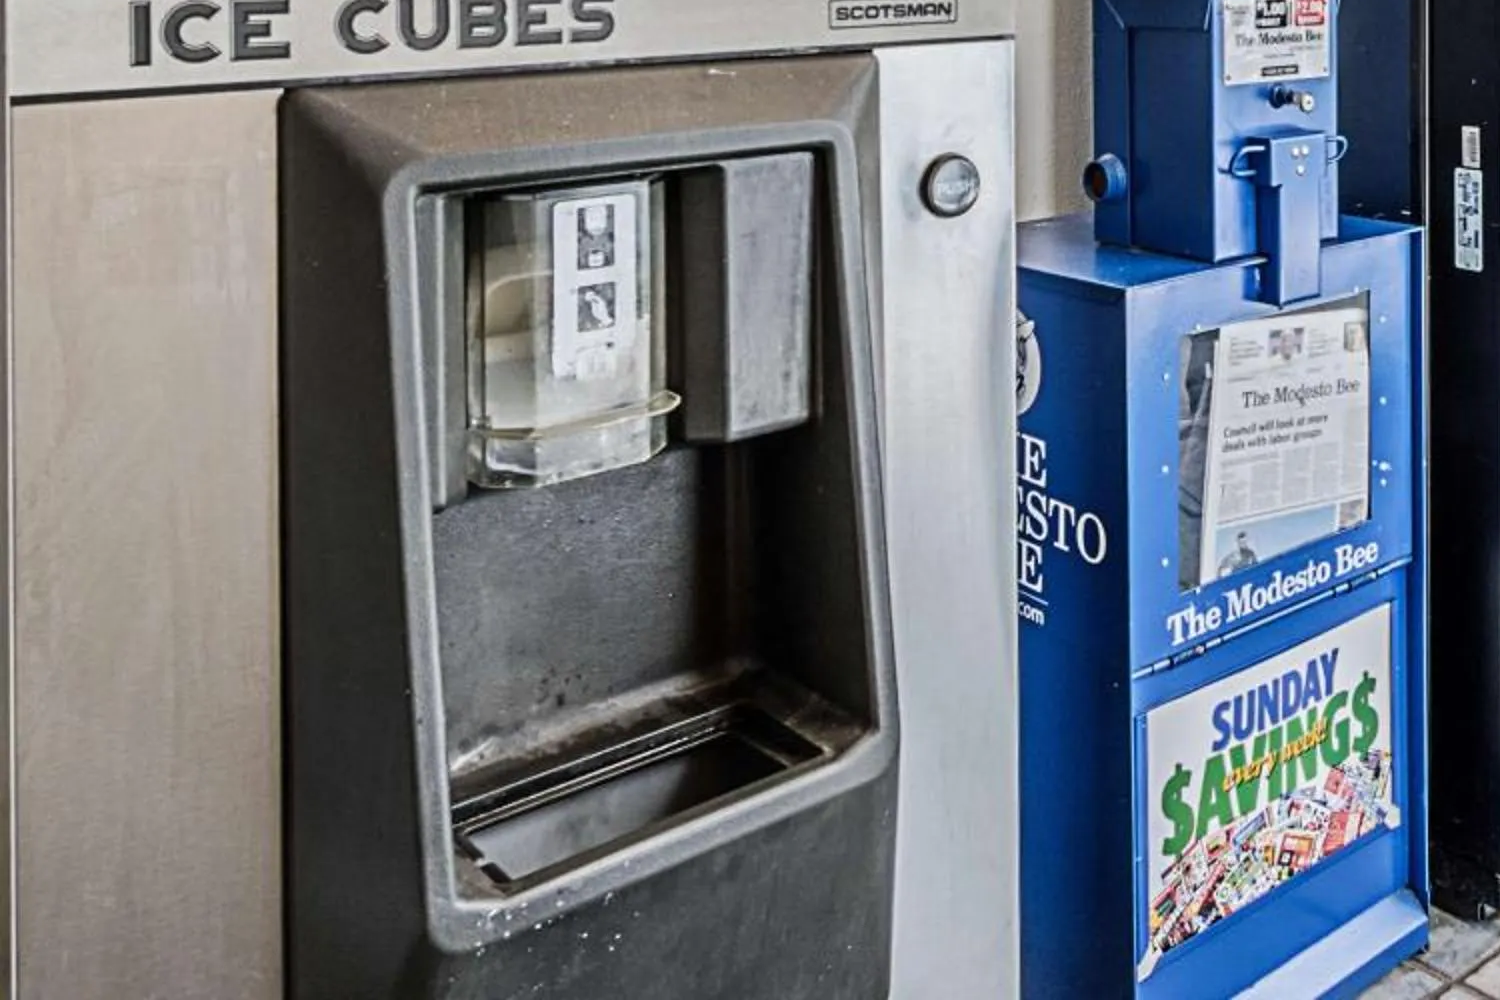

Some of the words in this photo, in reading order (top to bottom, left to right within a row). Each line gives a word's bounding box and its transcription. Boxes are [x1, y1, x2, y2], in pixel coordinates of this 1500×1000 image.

[835, 2, 953, 21] SCOTSMAN
[1235, 33, 1256, 47] The
[1242, 389, 1271, 409] The
[1274, 381, 1332, 405] Modesto
[1336, 378, 1361, 395] Bee
[1166, 602, 1222, 647] The
[1221, 556, 1331, 624] Modesto
[1335, 541, 1379, 577] Bee
[1212, 648, 1339, 752] SUNDAY
